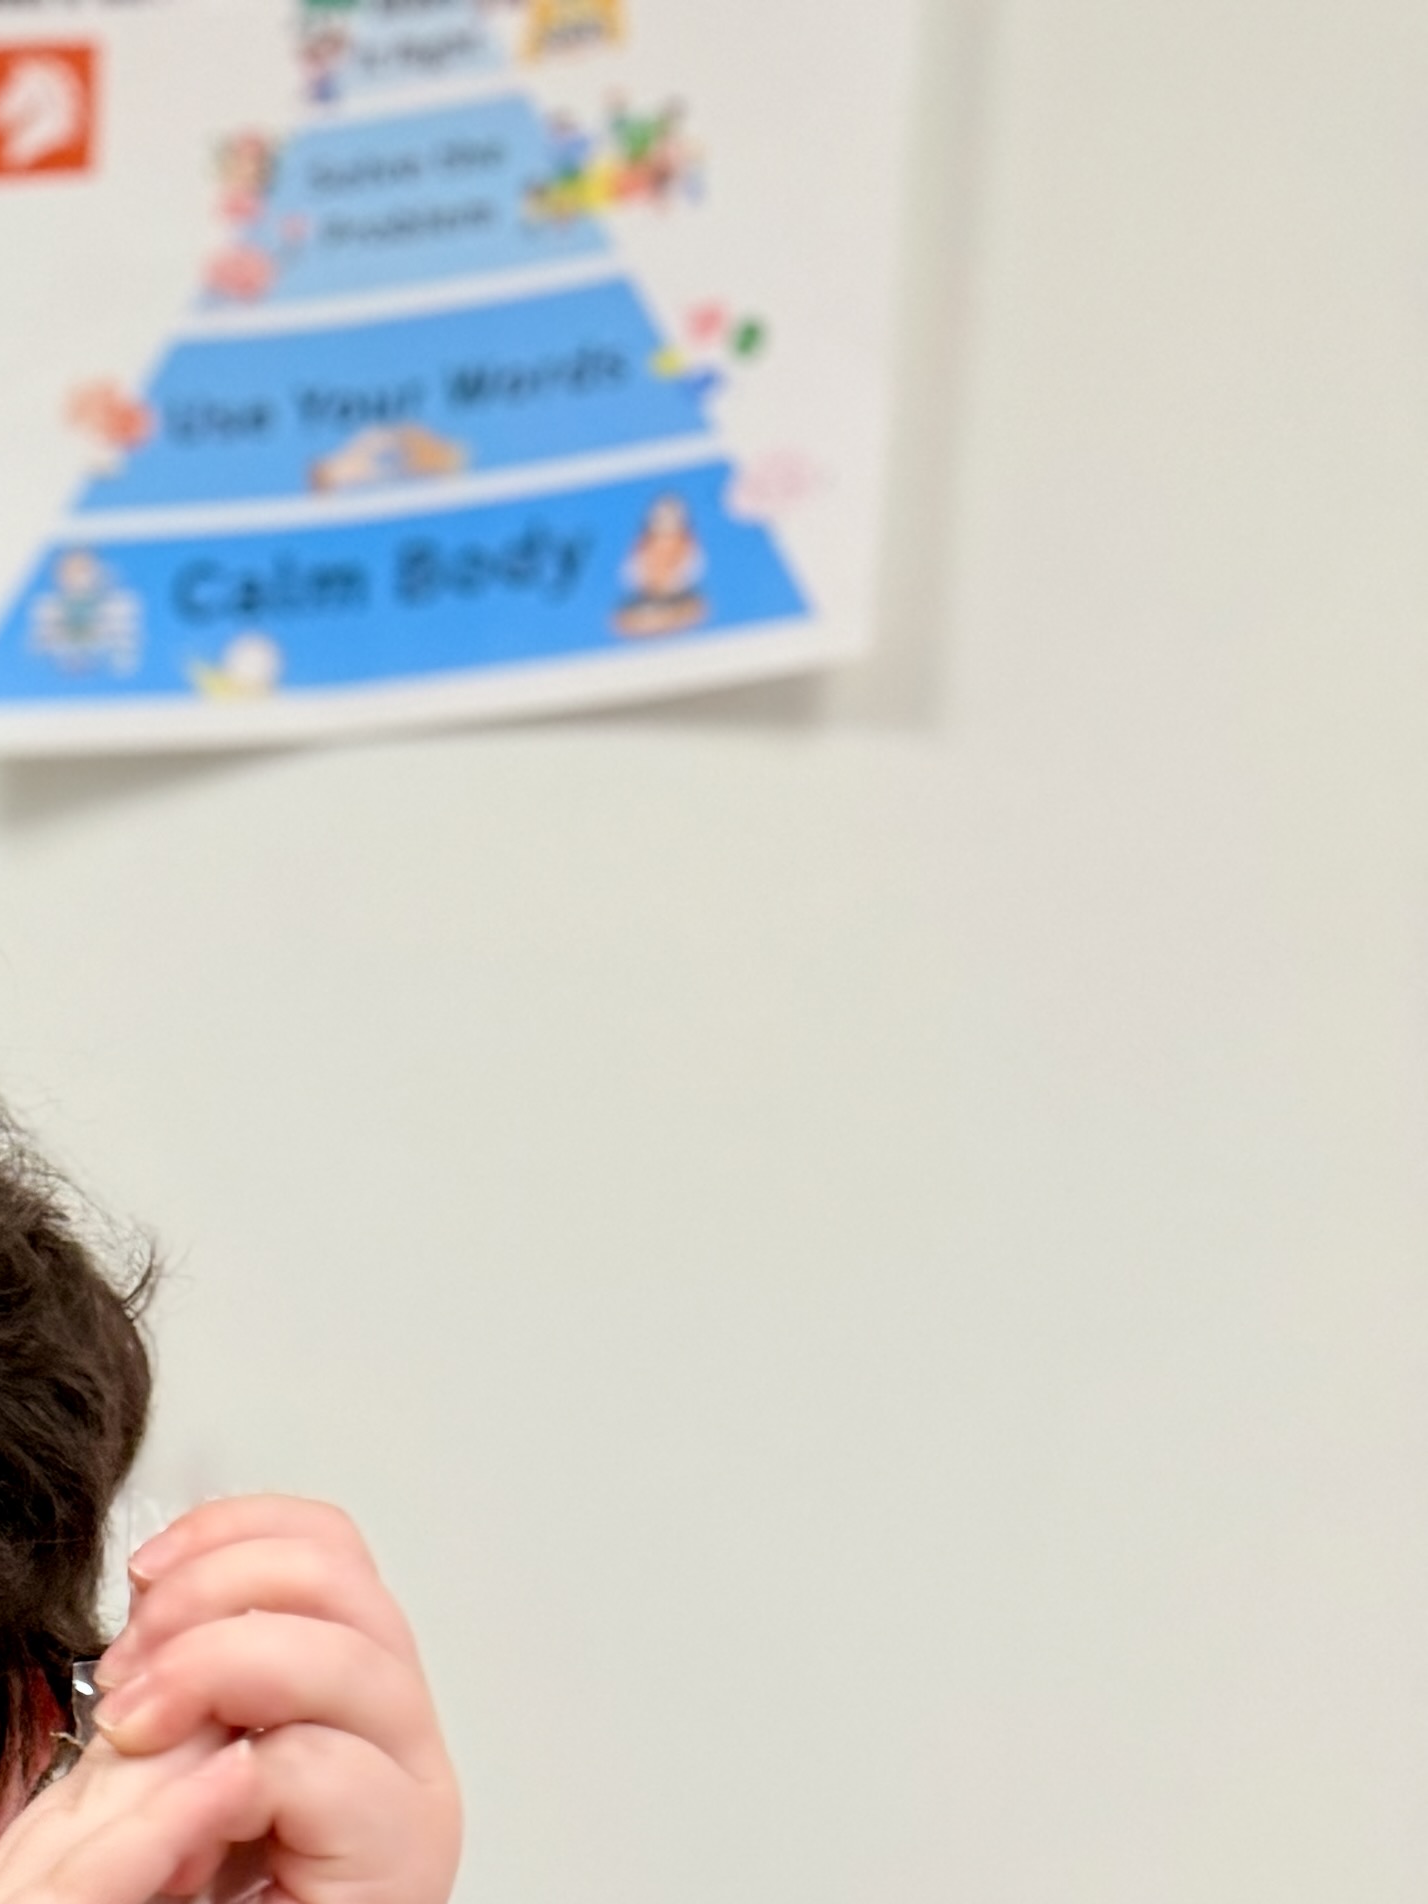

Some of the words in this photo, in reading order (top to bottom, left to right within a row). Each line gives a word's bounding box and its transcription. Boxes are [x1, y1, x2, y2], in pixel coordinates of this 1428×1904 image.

[292, 378, 422, 426] Your
[445, 346, 629, 413] Words
[170, 552, 371, 625] Calm
[392, 518, 596, 606] Body
